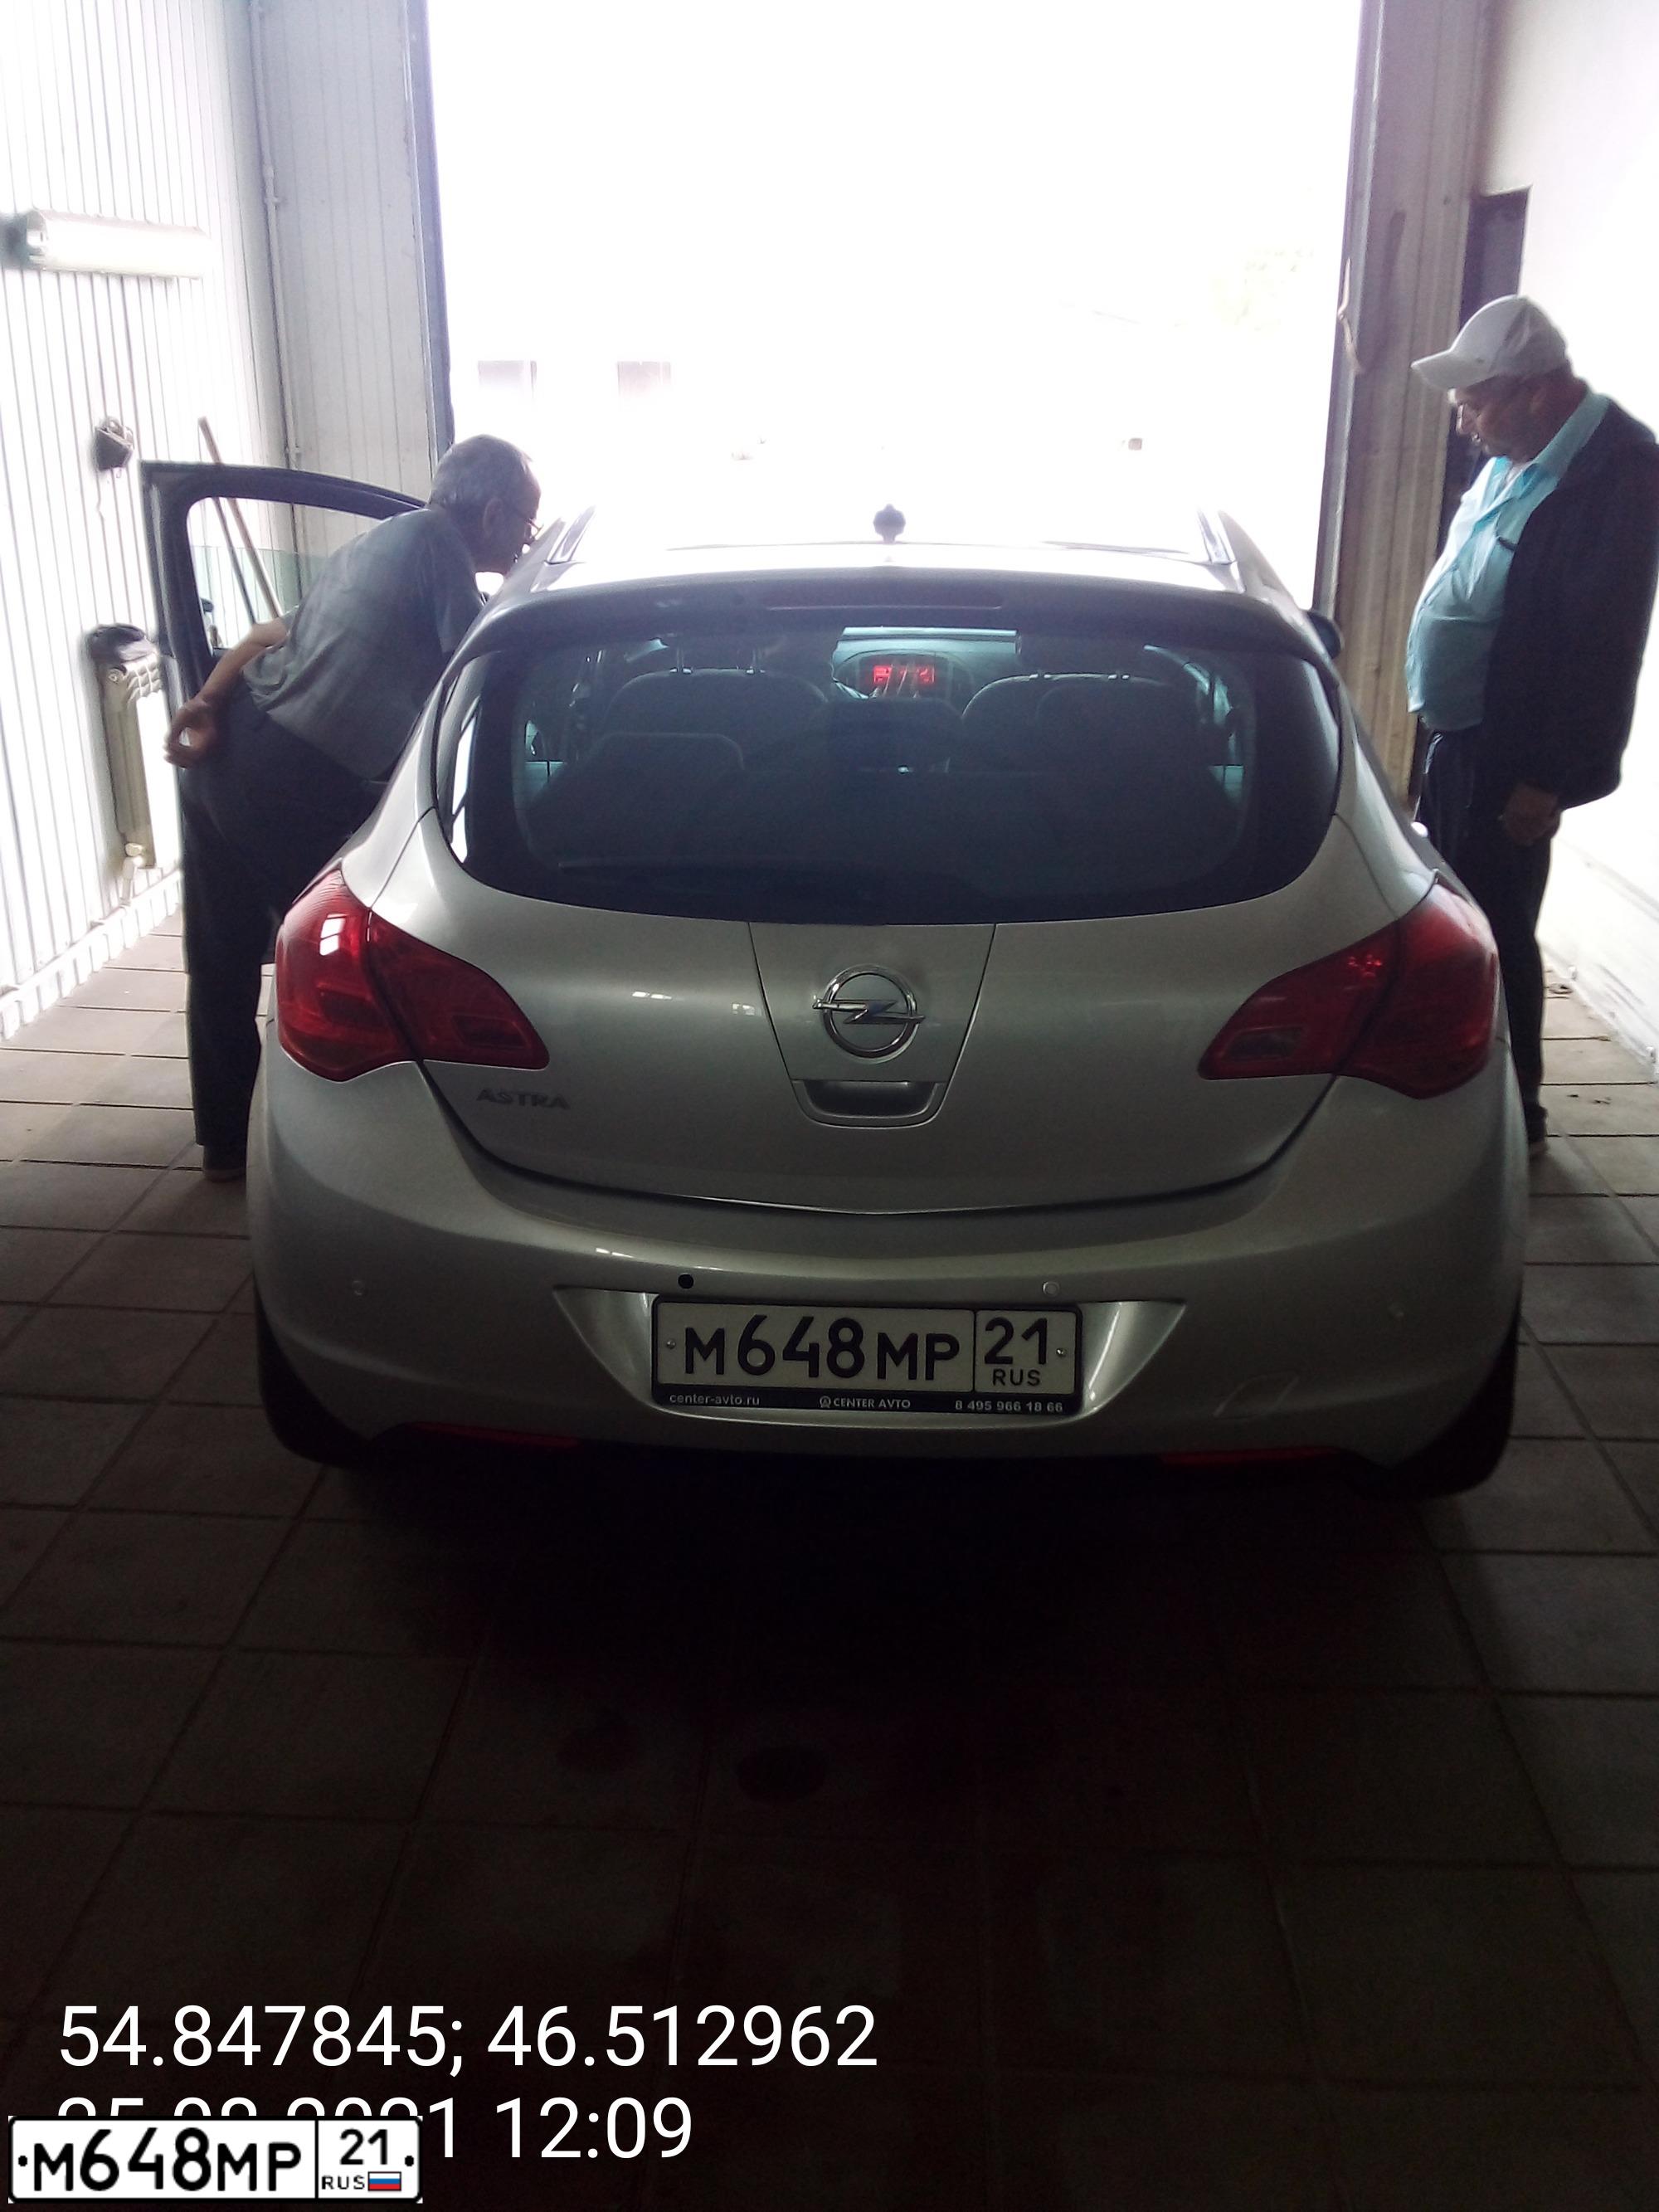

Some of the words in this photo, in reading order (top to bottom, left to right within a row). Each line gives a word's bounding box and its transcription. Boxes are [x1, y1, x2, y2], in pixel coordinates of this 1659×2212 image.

[476, 1089, 570, 1109] ASTRA
[984, 1317, 1049, 1366] 21
[992, 1368, 1042, 1386] RUS
[669, 1392, 761, 1406] center-avto.ru
[833, 1396, 875, 1408] CENTER
[878, 1399, 911, 1410] AVTO
[955, 1400, 963, 1410] 8
[967, 1400, 992, 1411] 495
[996, 1401, 1021, 1411] 966
[1026, 1401, 1042, 1411] 18
[1047, 1402, 1063, 1412] 66
